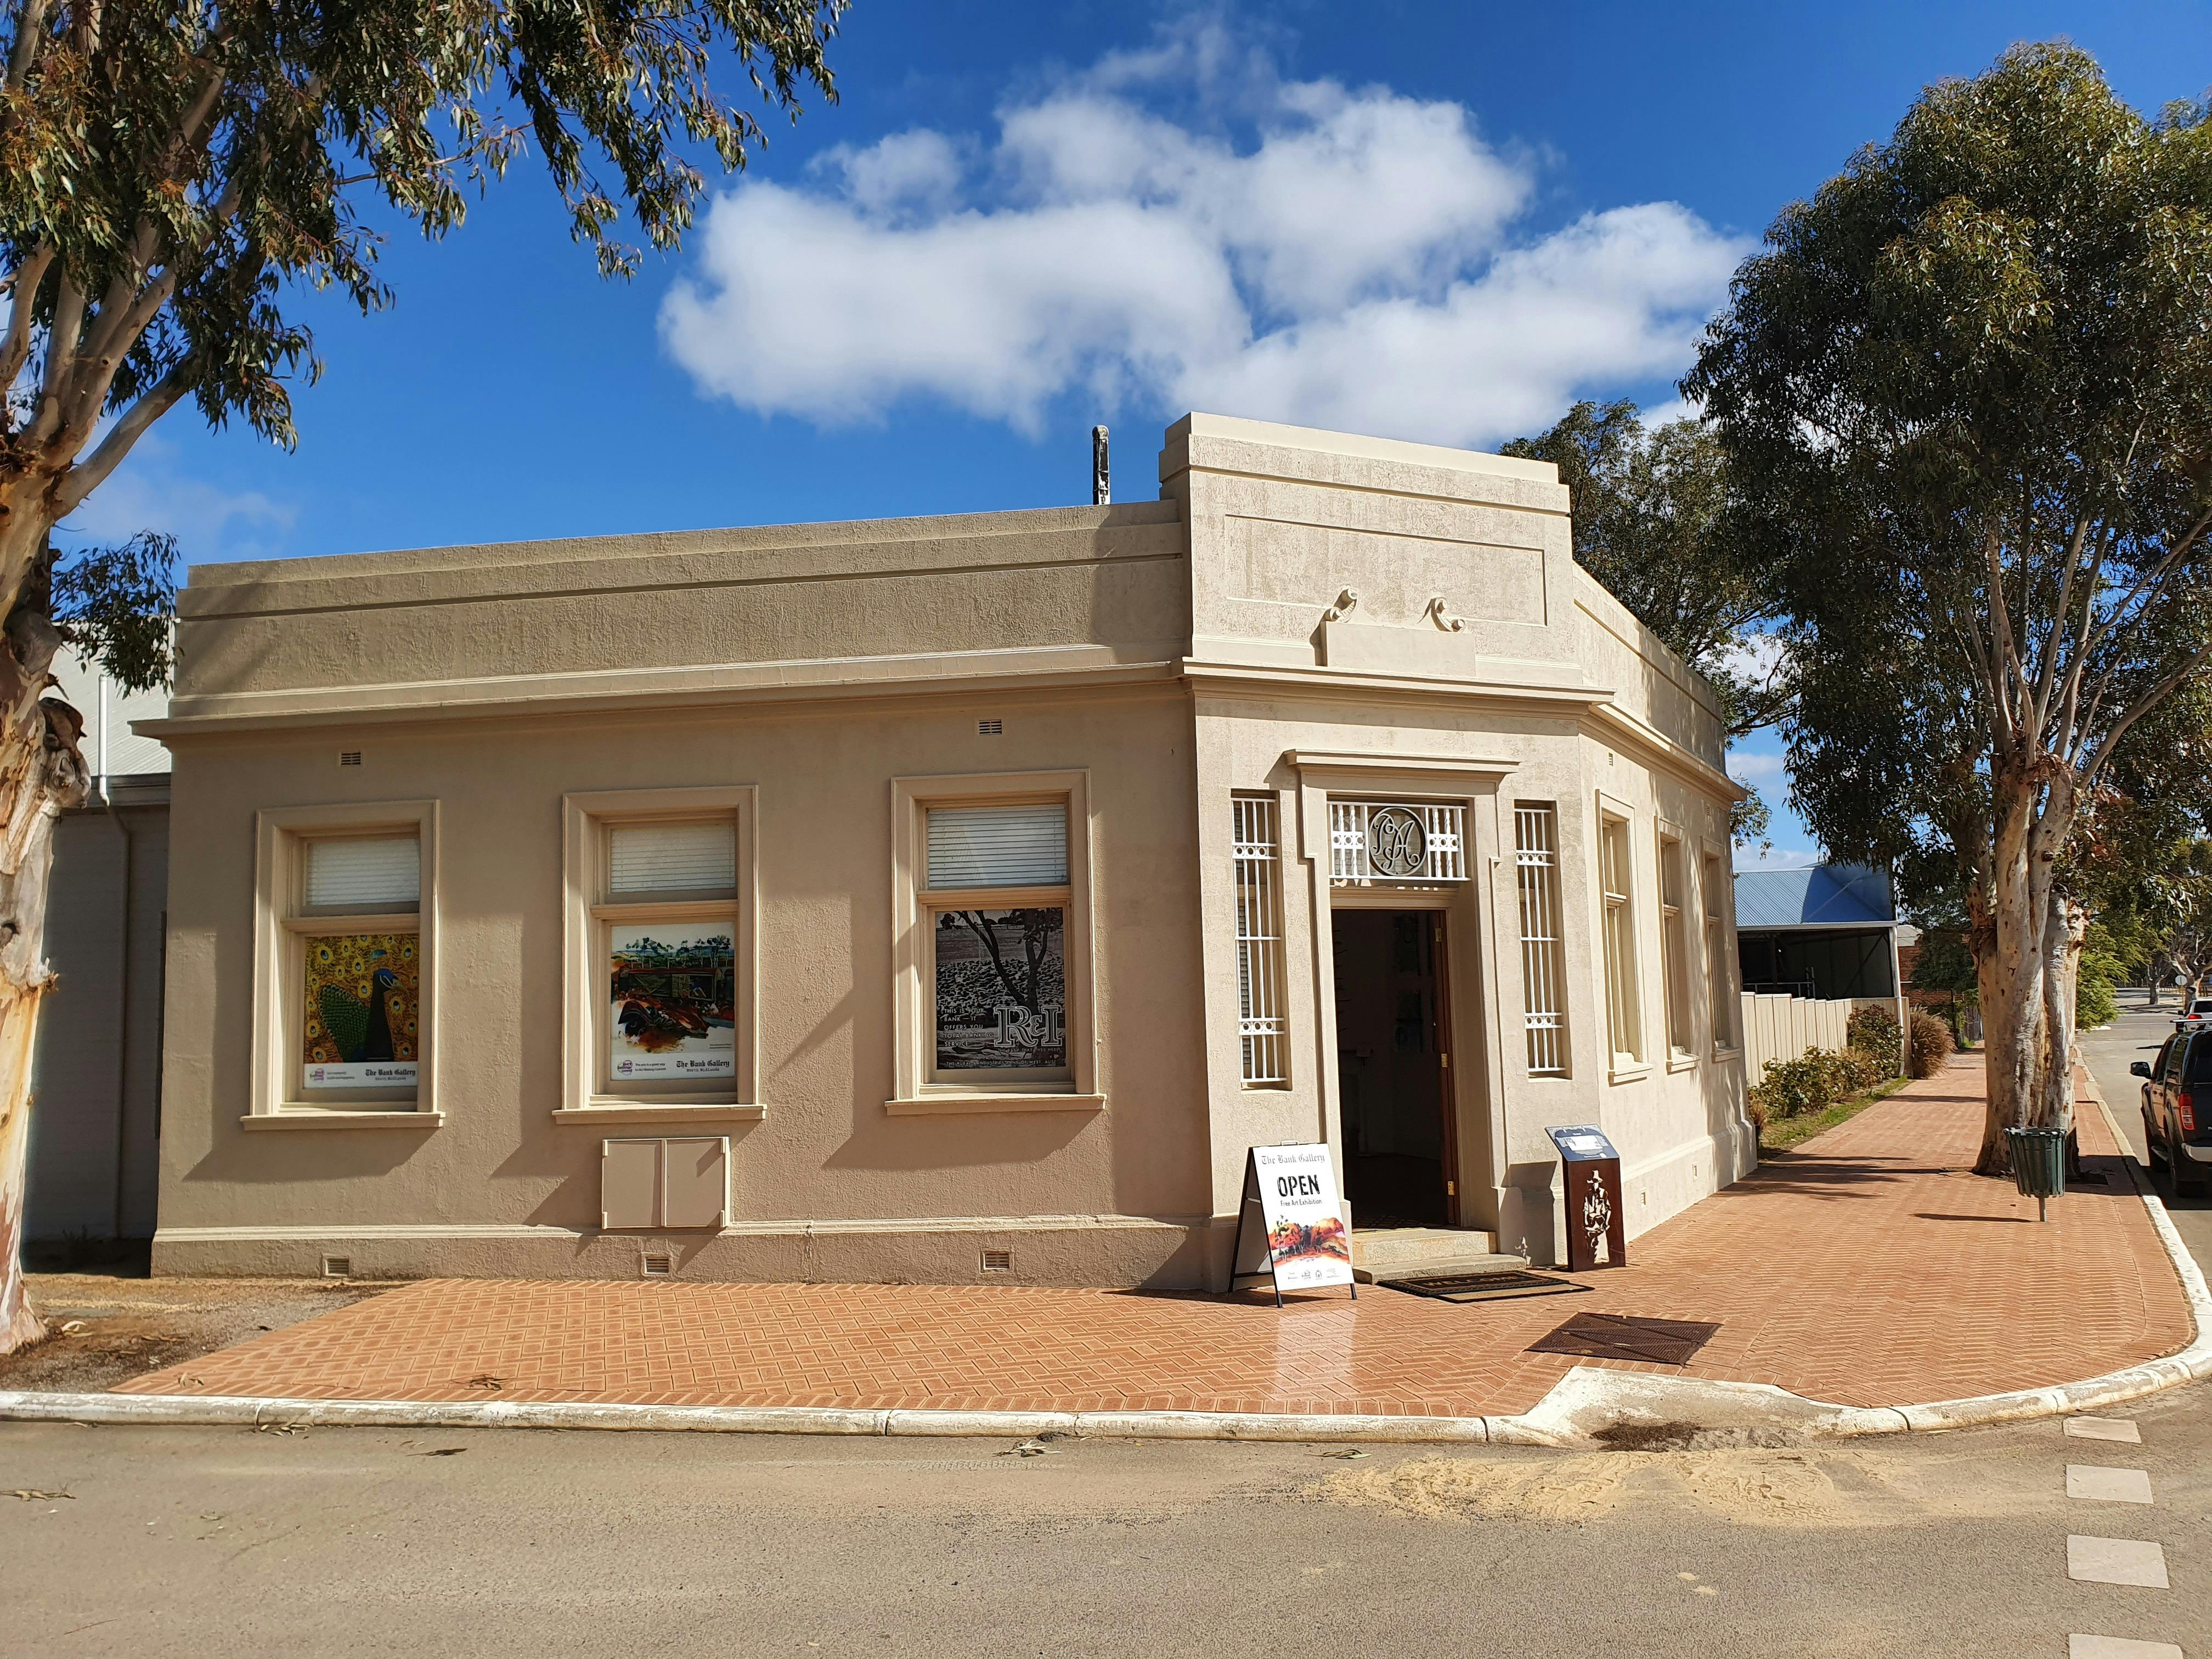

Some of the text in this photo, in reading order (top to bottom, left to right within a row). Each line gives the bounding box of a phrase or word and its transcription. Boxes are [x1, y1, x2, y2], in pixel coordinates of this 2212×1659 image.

[707, 1059, 730, 1068] Gallery
[394, 1068, 416, 1076] Gallery
[1261, 1154, 1325, 1165] The Bank Gallery
[1277, 1175, 1320, 1197] OPEN
